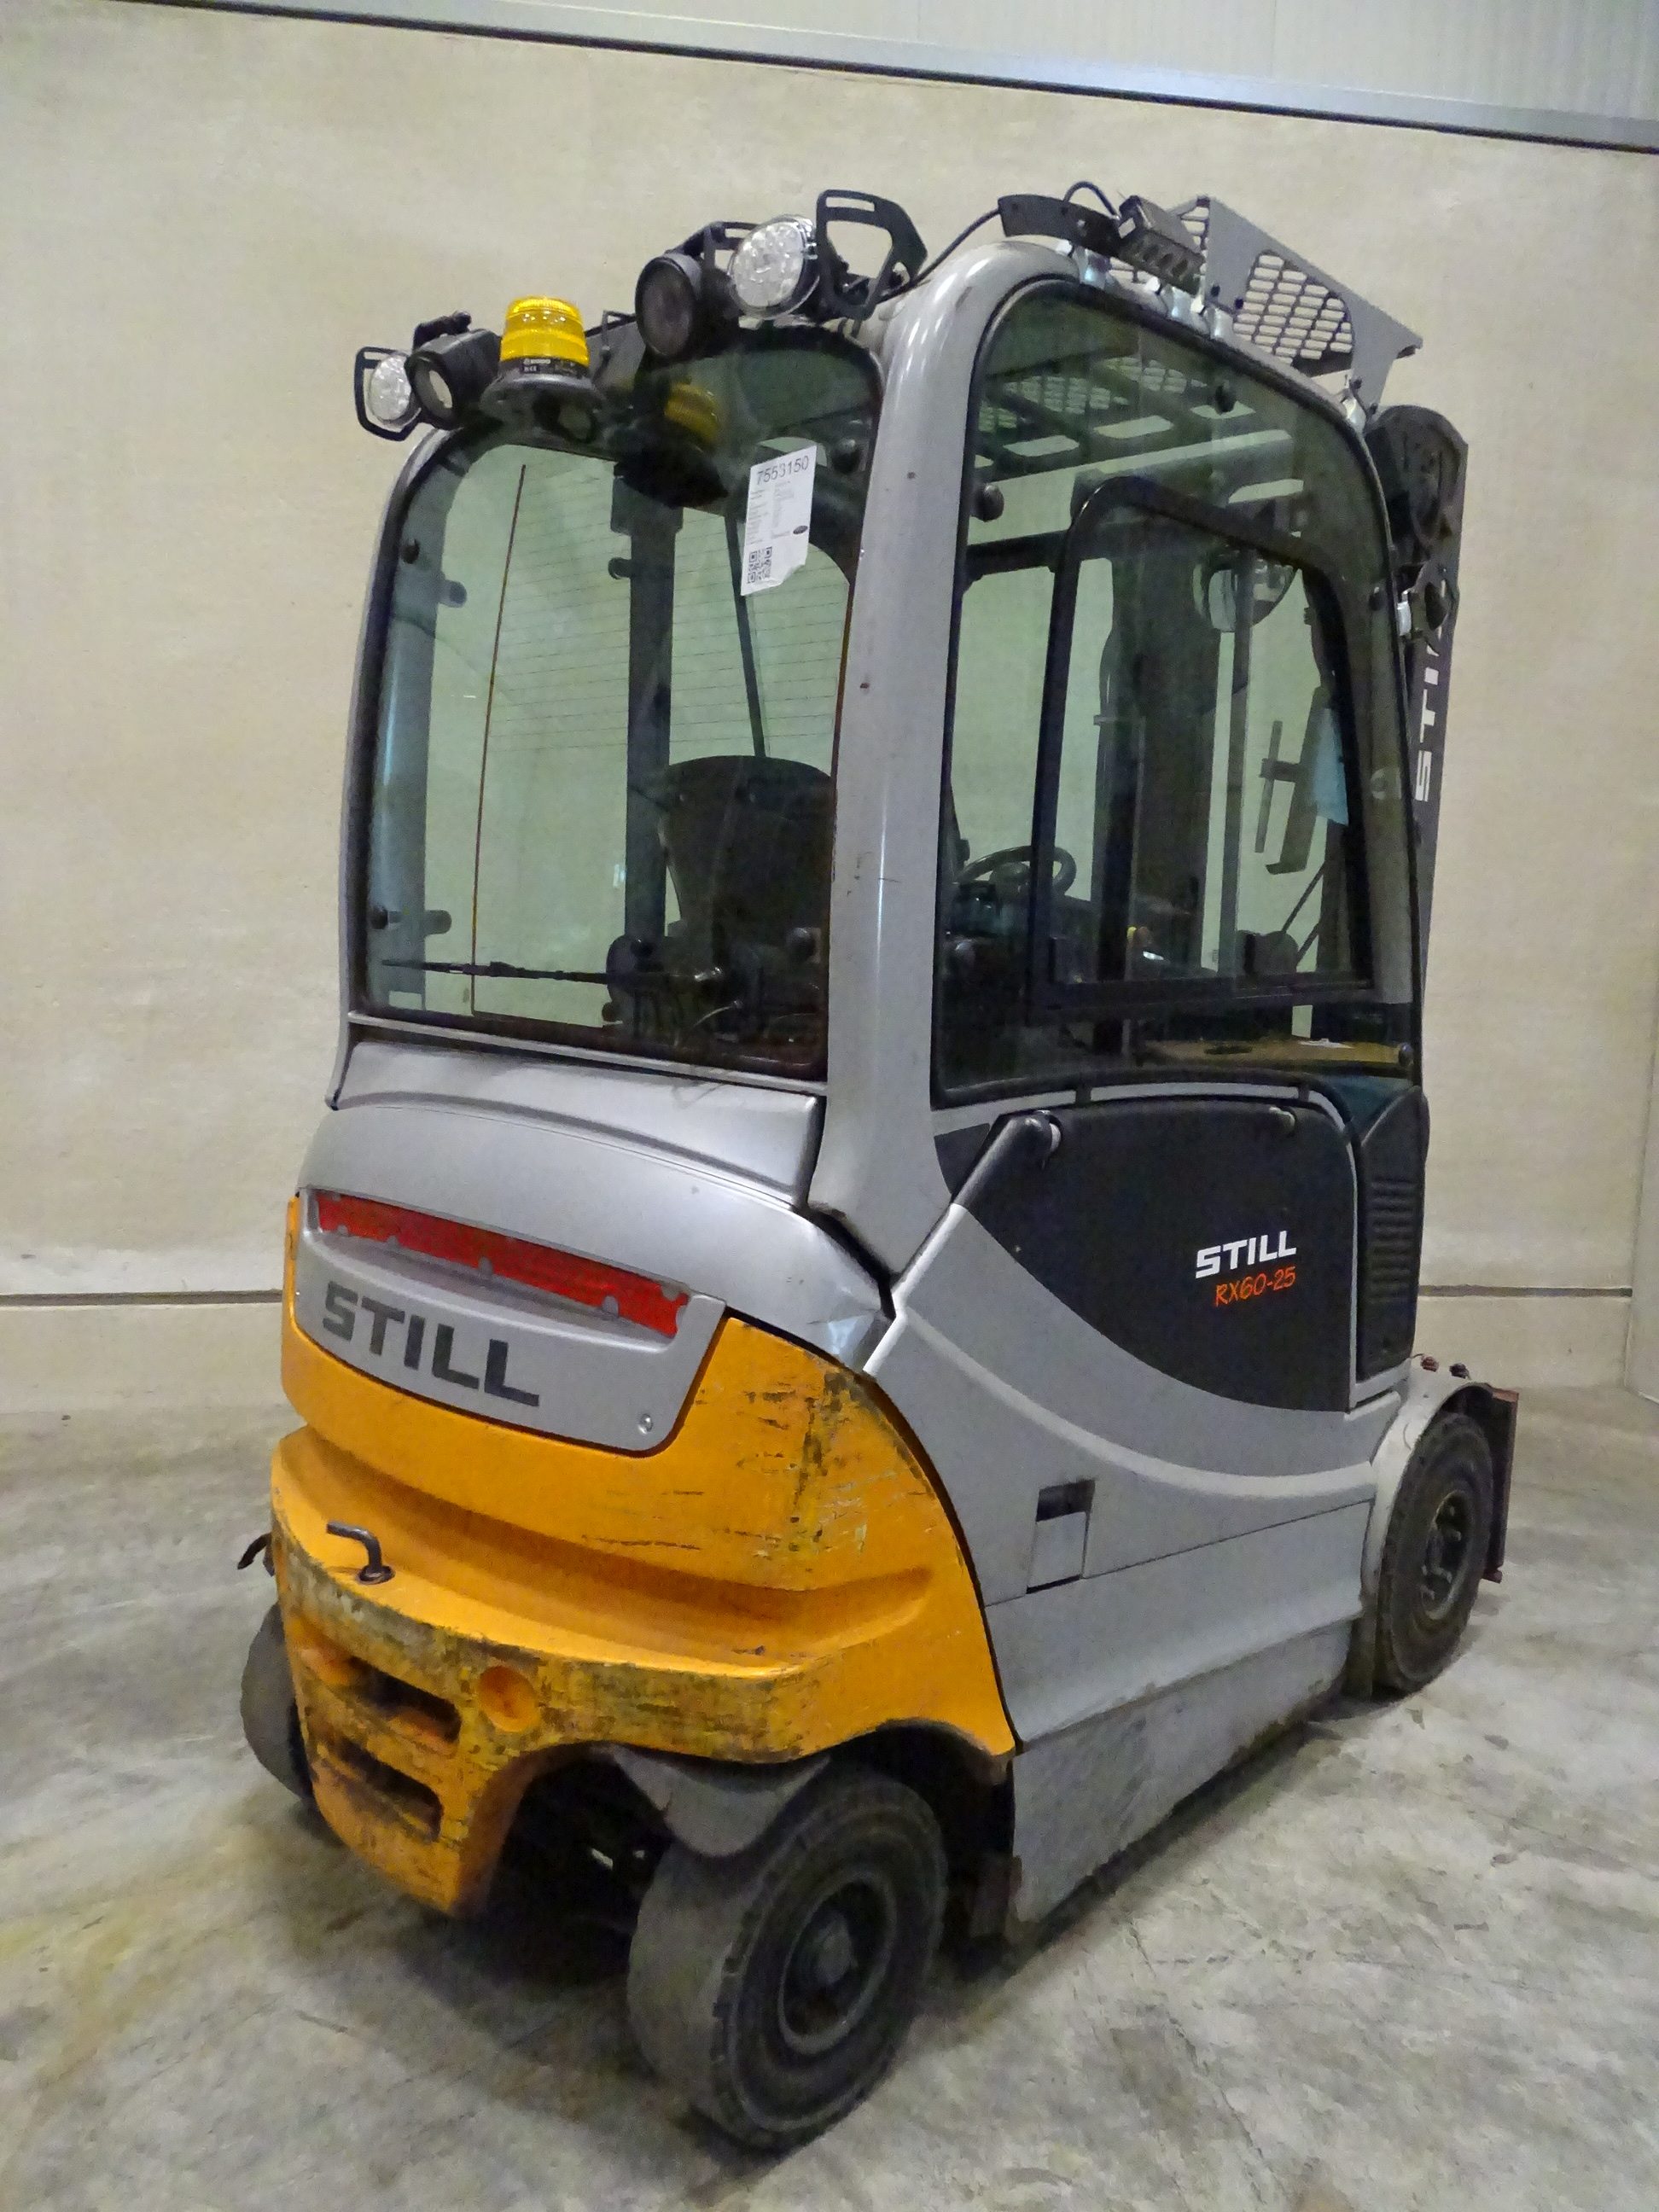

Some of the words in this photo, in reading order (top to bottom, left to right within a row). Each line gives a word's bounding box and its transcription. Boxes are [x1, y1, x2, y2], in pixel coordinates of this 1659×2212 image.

[757, 455, 809, 485] 7553150
[1415, 579, 1446, 802] STI
[1196, 1231, 1297, 1279] STILL
[1215, 1266, 1296, 1307] RX60-25
[322, 1280, 540, 1407] STILL
